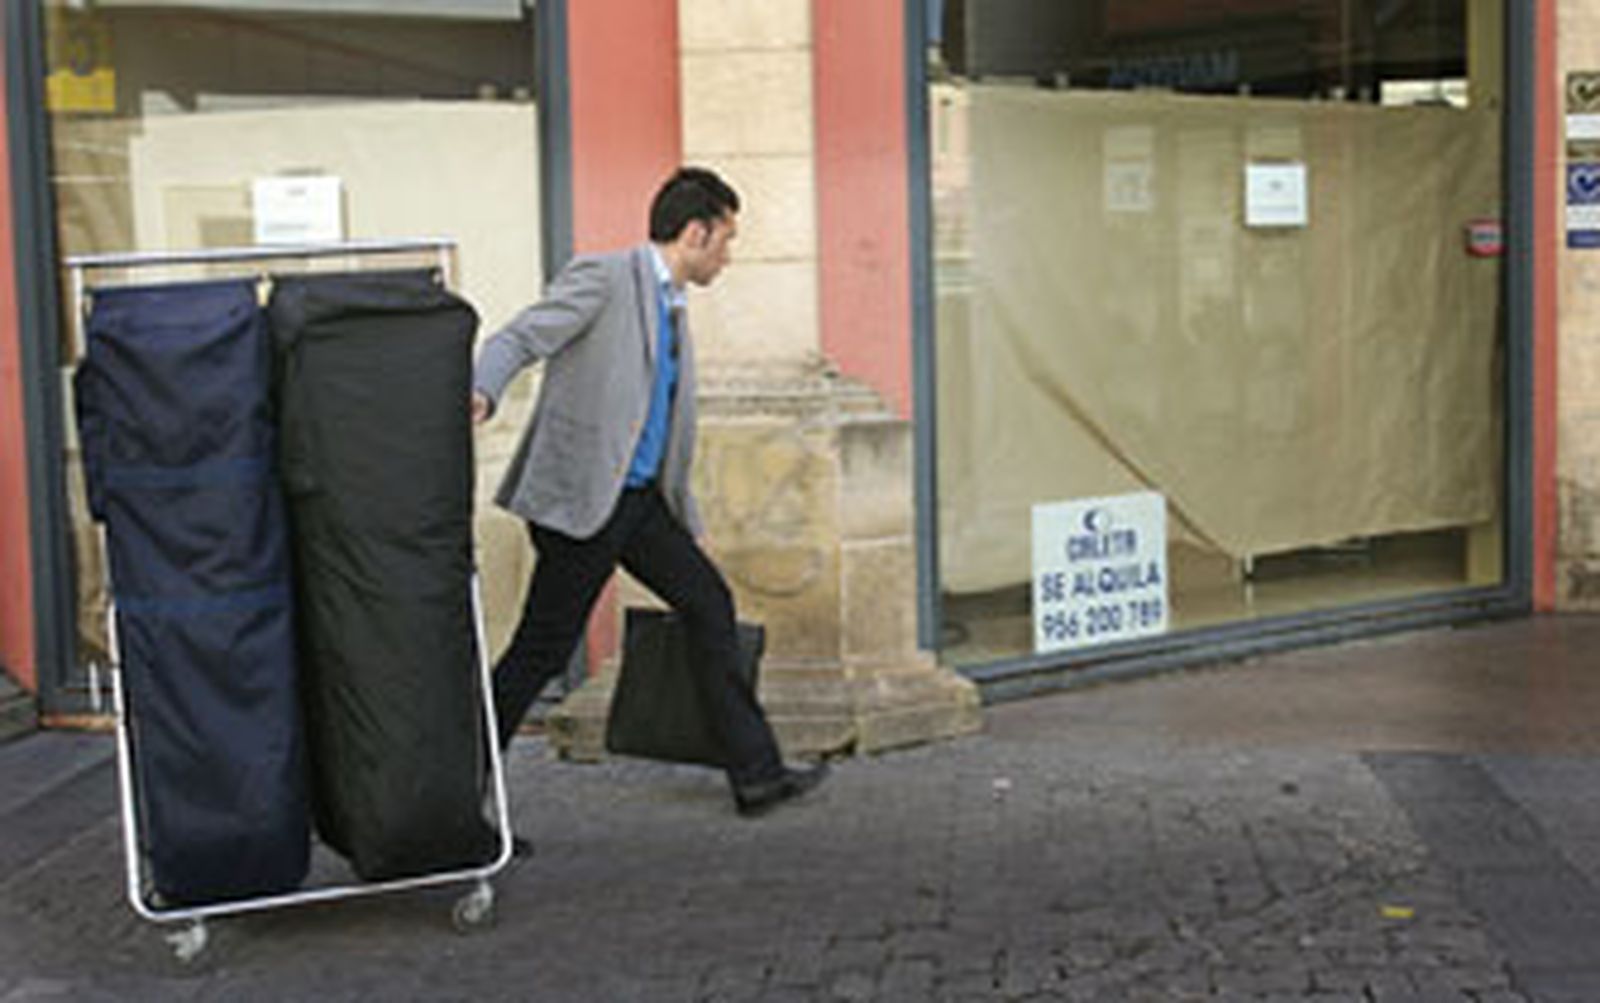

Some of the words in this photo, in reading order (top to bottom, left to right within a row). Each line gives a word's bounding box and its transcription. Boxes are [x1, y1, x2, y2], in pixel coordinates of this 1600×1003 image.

[1041, 572, 1066, 603] SE
[1073, 561, 1161, 597] ALQUILA
[1042, 611, 1079, 641] 956
[1085, 604, 1122, 636] 200
